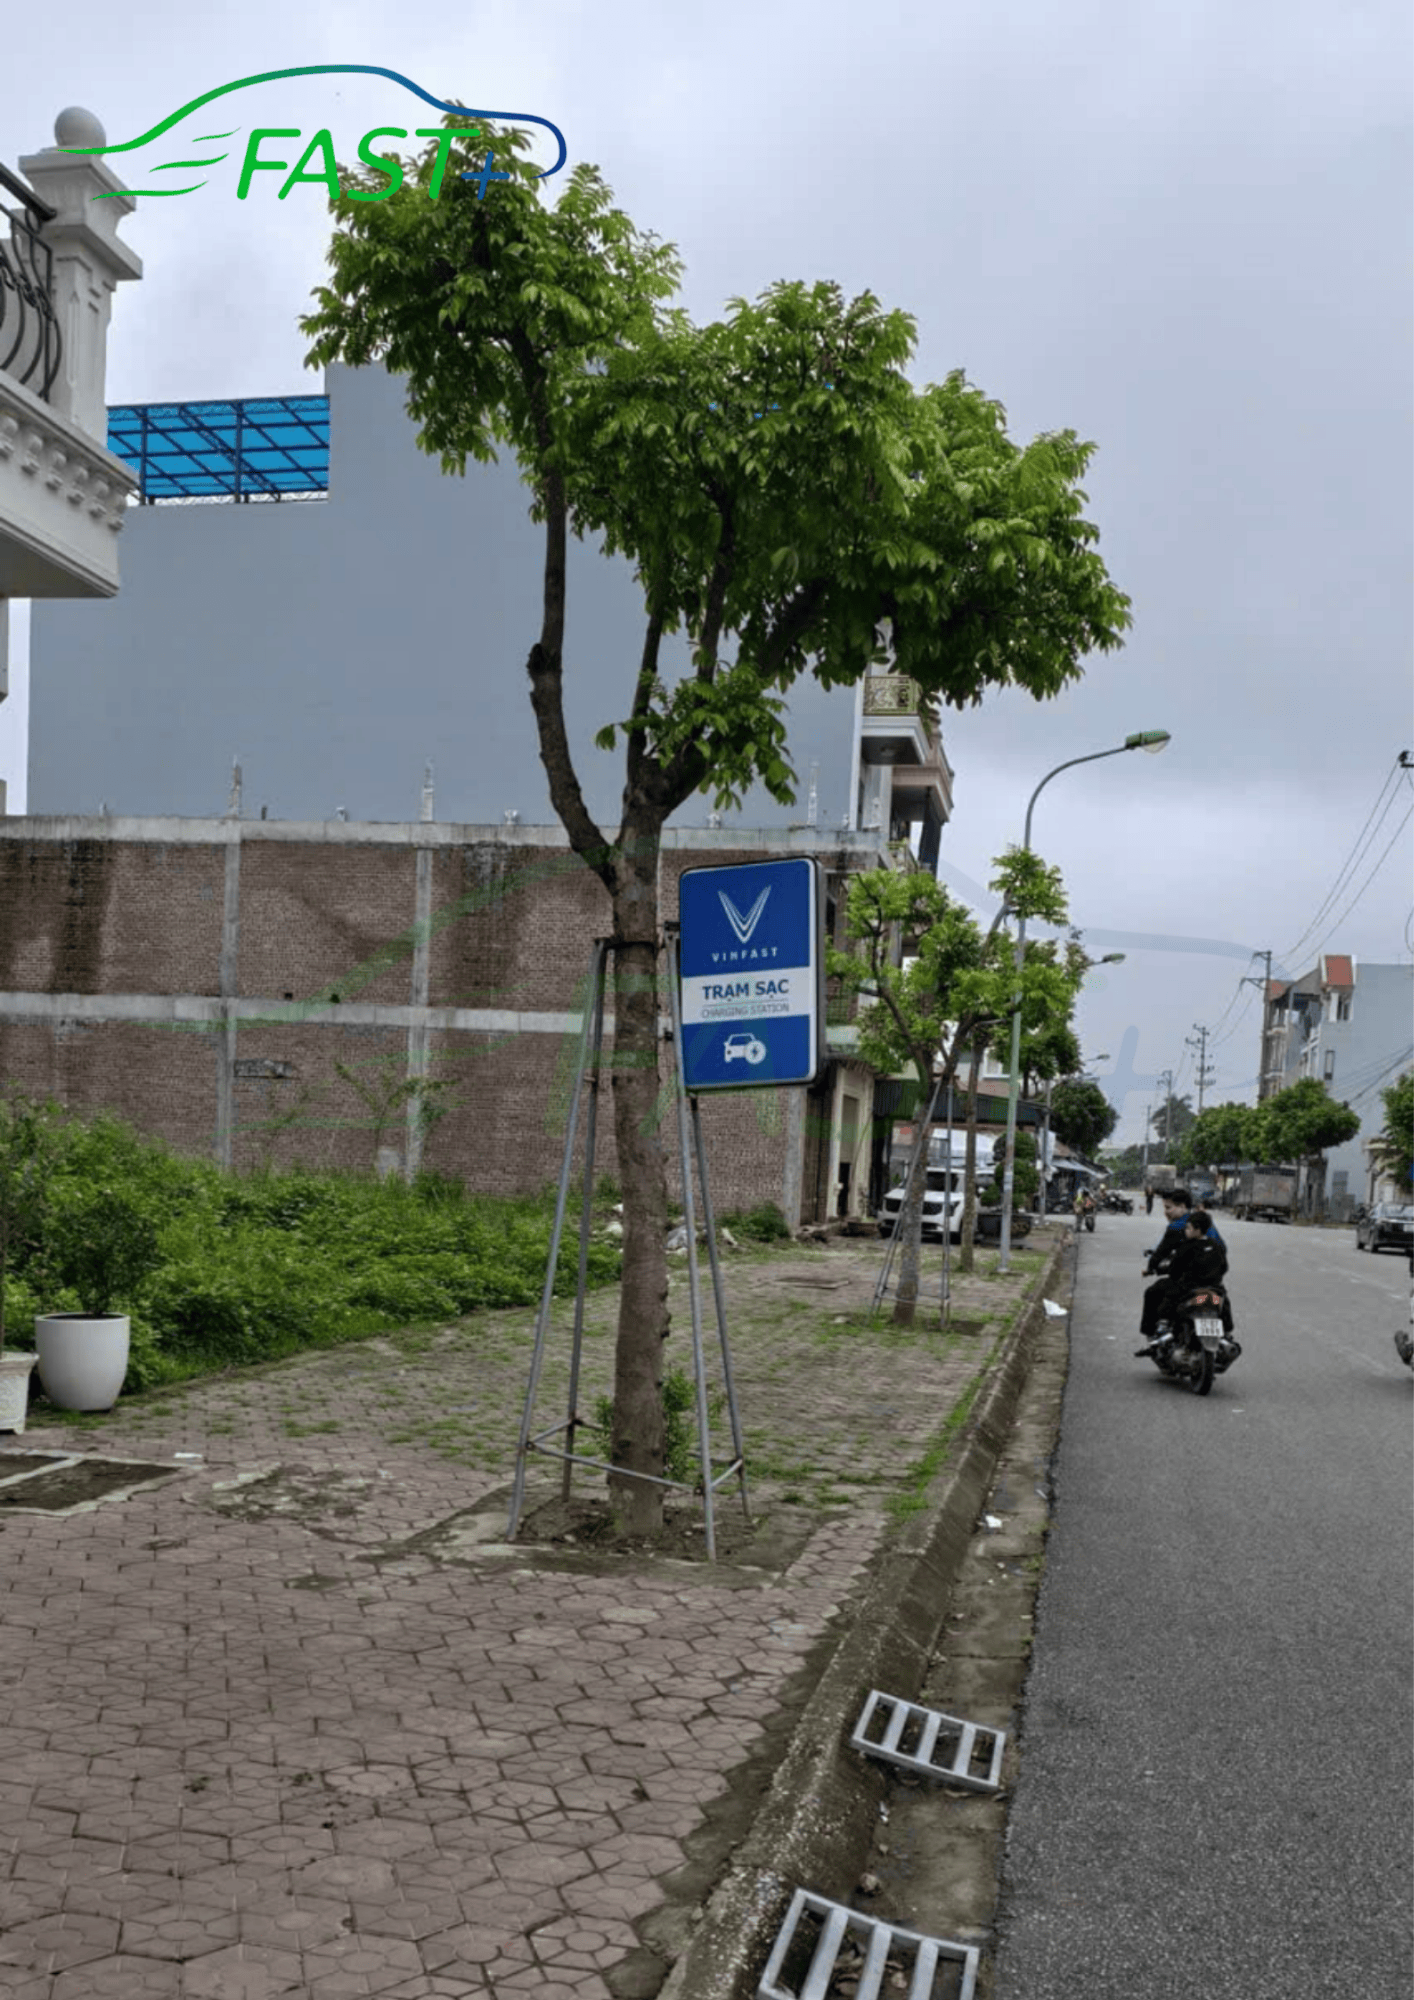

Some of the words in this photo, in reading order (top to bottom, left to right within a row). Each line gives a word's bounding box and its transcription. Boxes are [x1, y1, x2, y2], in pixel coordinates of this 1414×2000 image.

[711, 946, 778, 962] VINFAST
[702, 982, 749, 1002] TRẠM
[755, 978, 789, 998] SẠC
[702, 1005, 748, 1018] CHARGING
[750, 1003, 790, 1014] STATION
